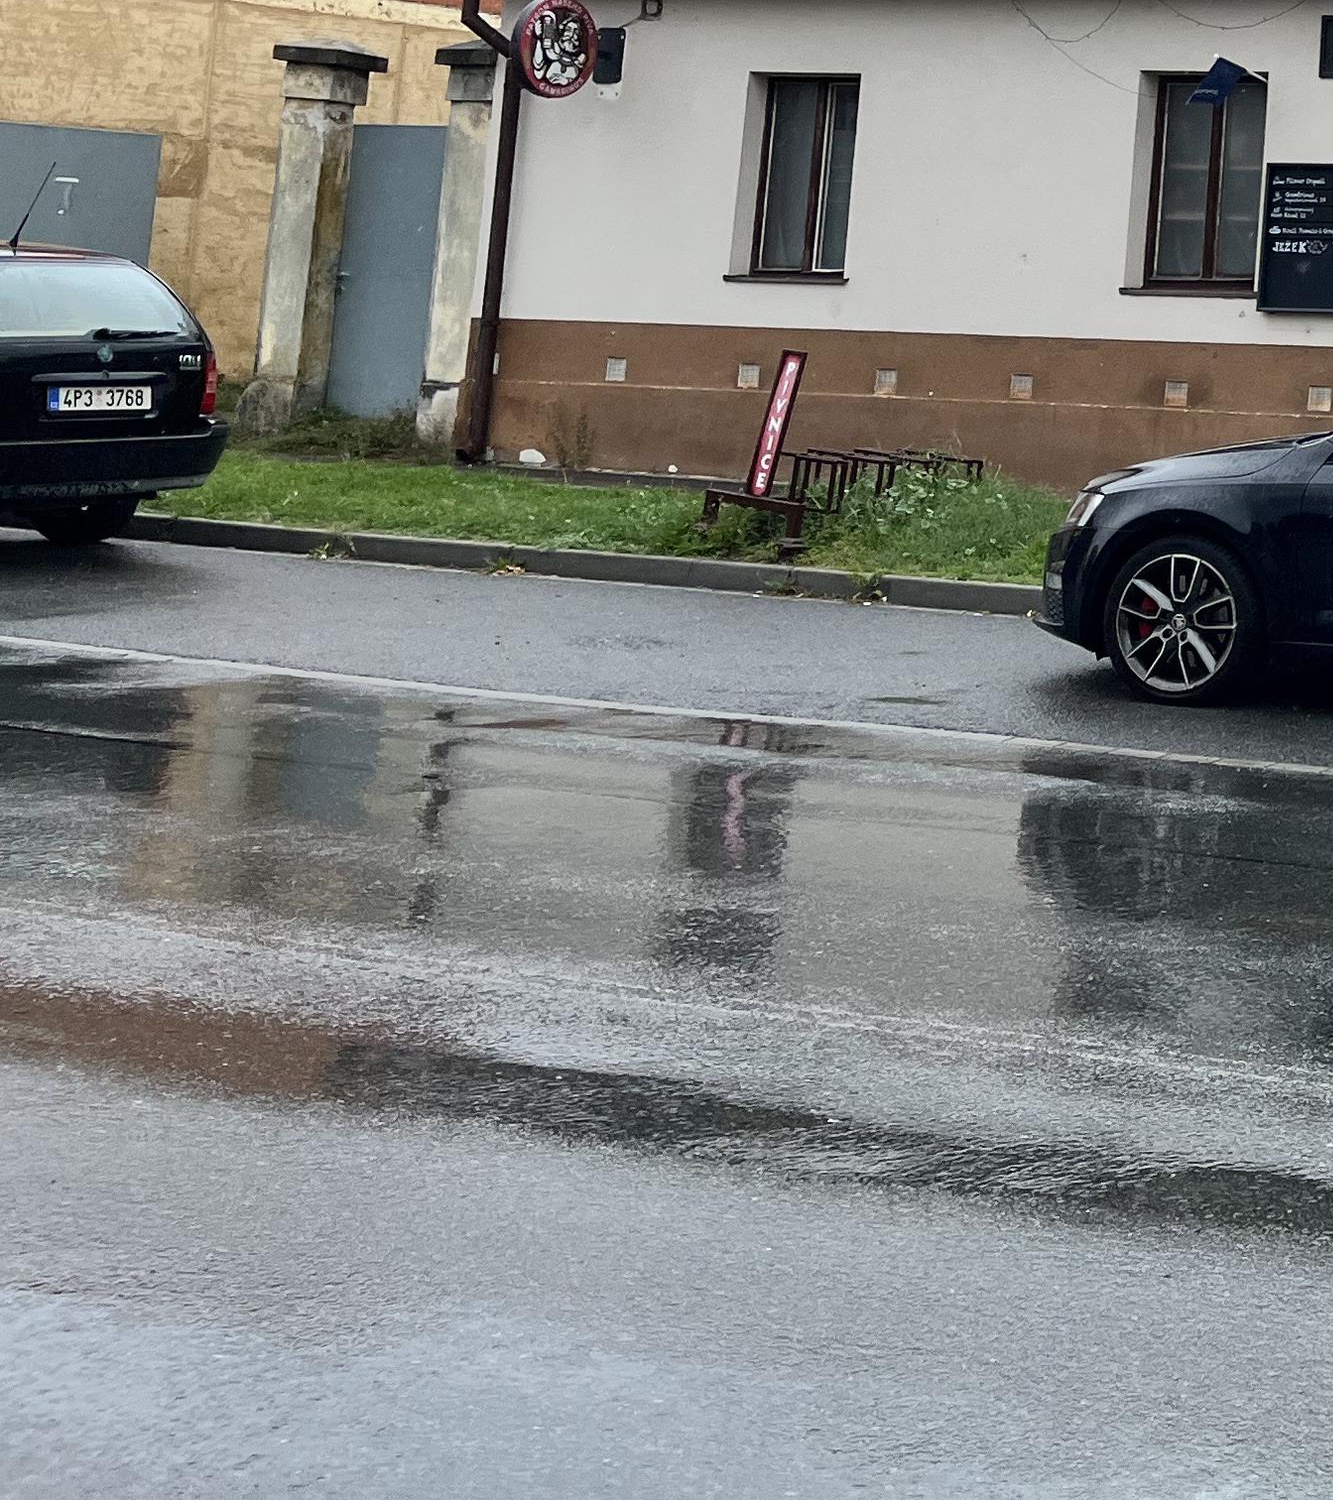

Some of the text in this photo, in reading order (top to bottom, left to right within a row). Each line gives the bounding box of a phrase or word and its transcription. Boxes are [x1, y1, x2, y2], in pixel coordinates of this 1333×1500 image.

[63, 389, 144, 408] 4P3 3768
[755, 361, 800, 489] PIVNICE
